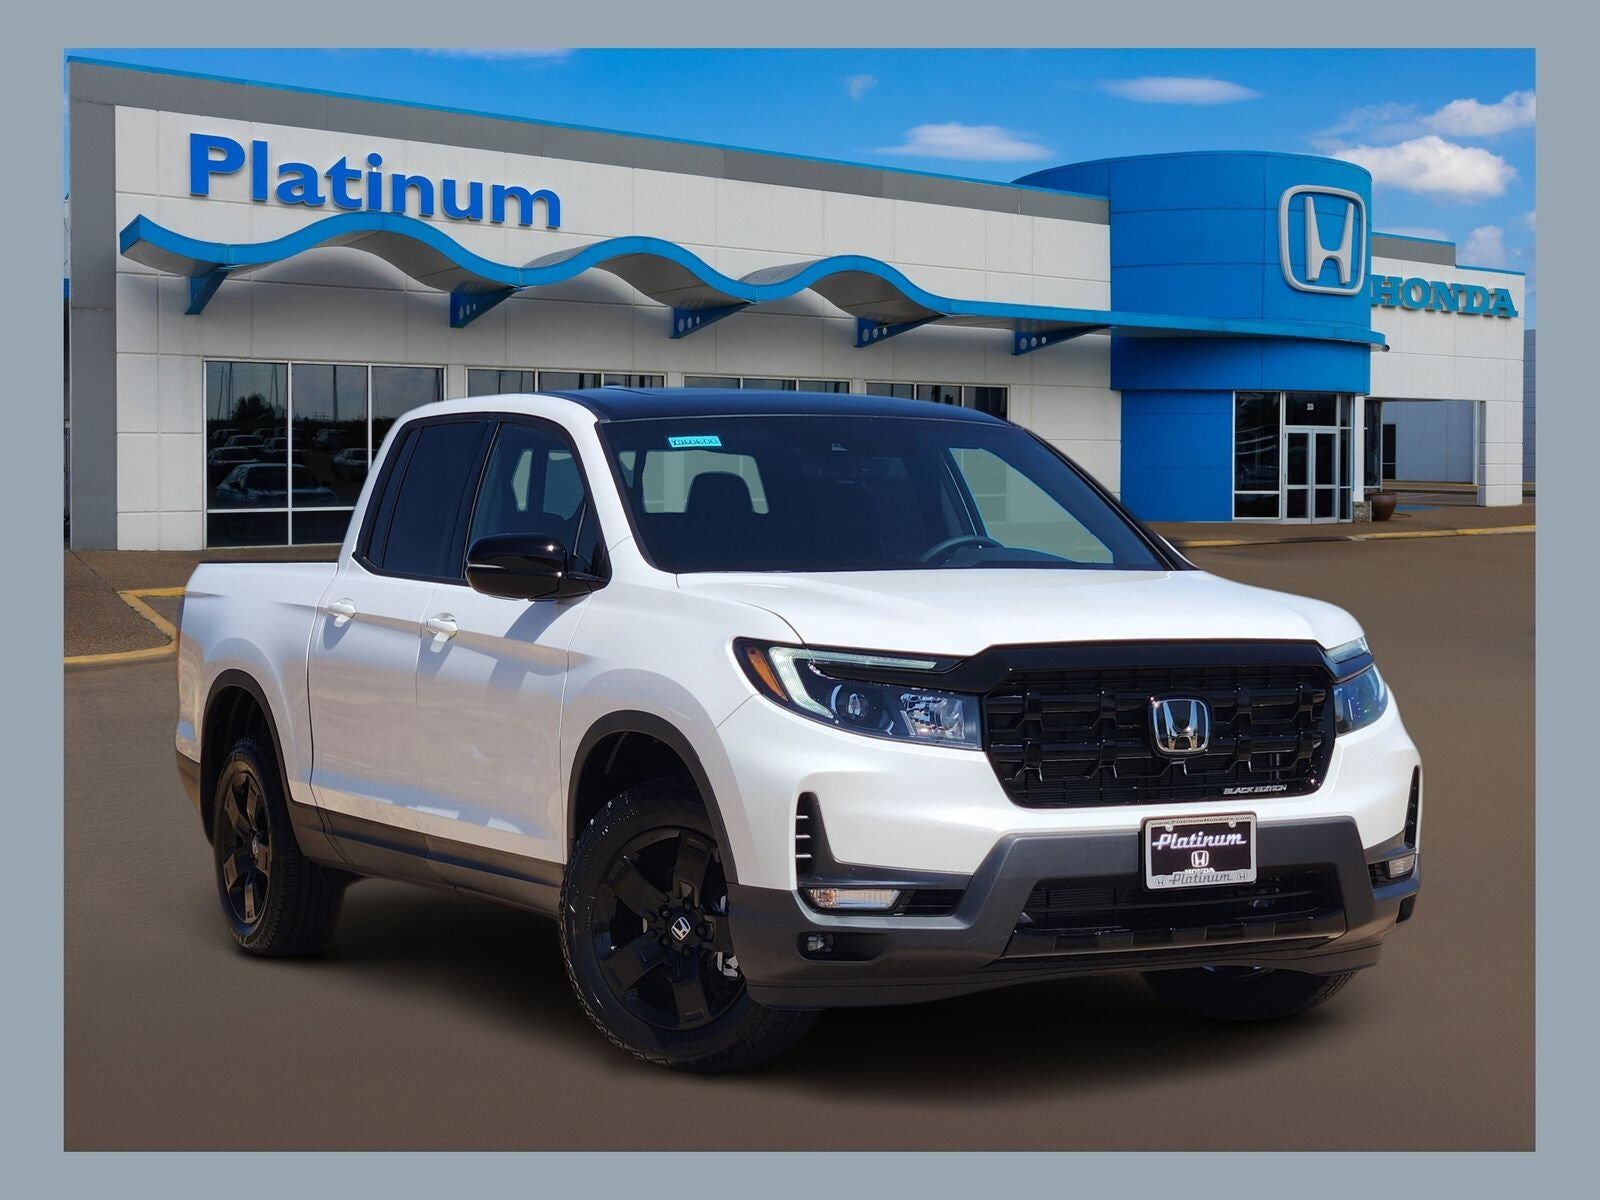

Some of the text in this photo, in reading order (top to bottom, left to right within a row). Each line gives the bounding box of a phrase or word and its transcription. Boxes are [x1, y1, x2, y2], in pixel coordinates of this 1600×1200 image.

[189, 132, 561, 229] Platinum
[1371, 274, 1519, 318] HONDA
[1223, 784, 1287, 795] BLACK EDITION
[1151, 831, 1247, 850] Platinum
[1169, 872, 1233, 885] Platinum
